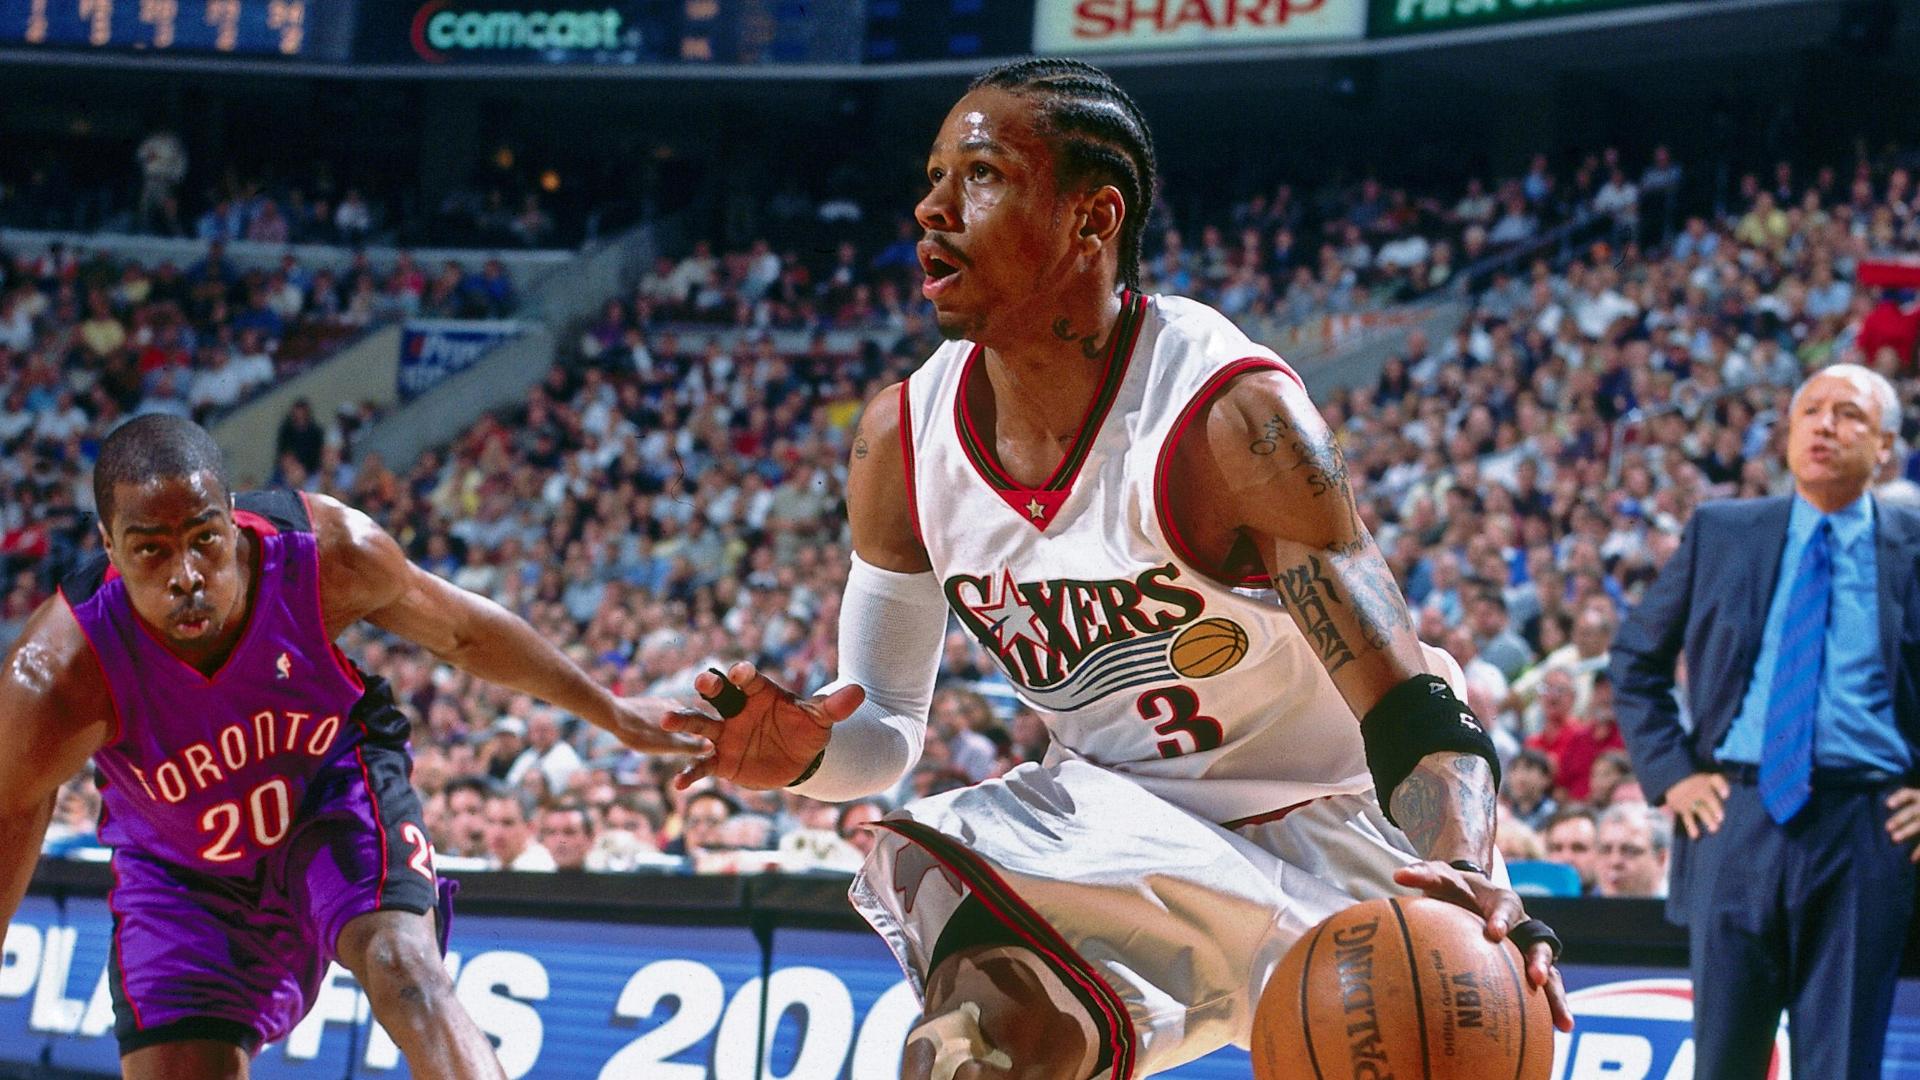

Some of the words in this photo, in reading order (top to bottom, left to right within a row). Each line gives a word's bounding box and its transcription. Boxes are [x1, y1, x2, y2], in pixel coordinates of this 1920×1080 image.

[427, 8, 623, 49] comcast
[1073, 0, 1326, 40] SHARP
[1136, 684, 1224, 759] 3
[200, 774, 293, 863] 20
[400, 821, 440, 900] 2
[1452, 971, 1484, 1029] NBA
